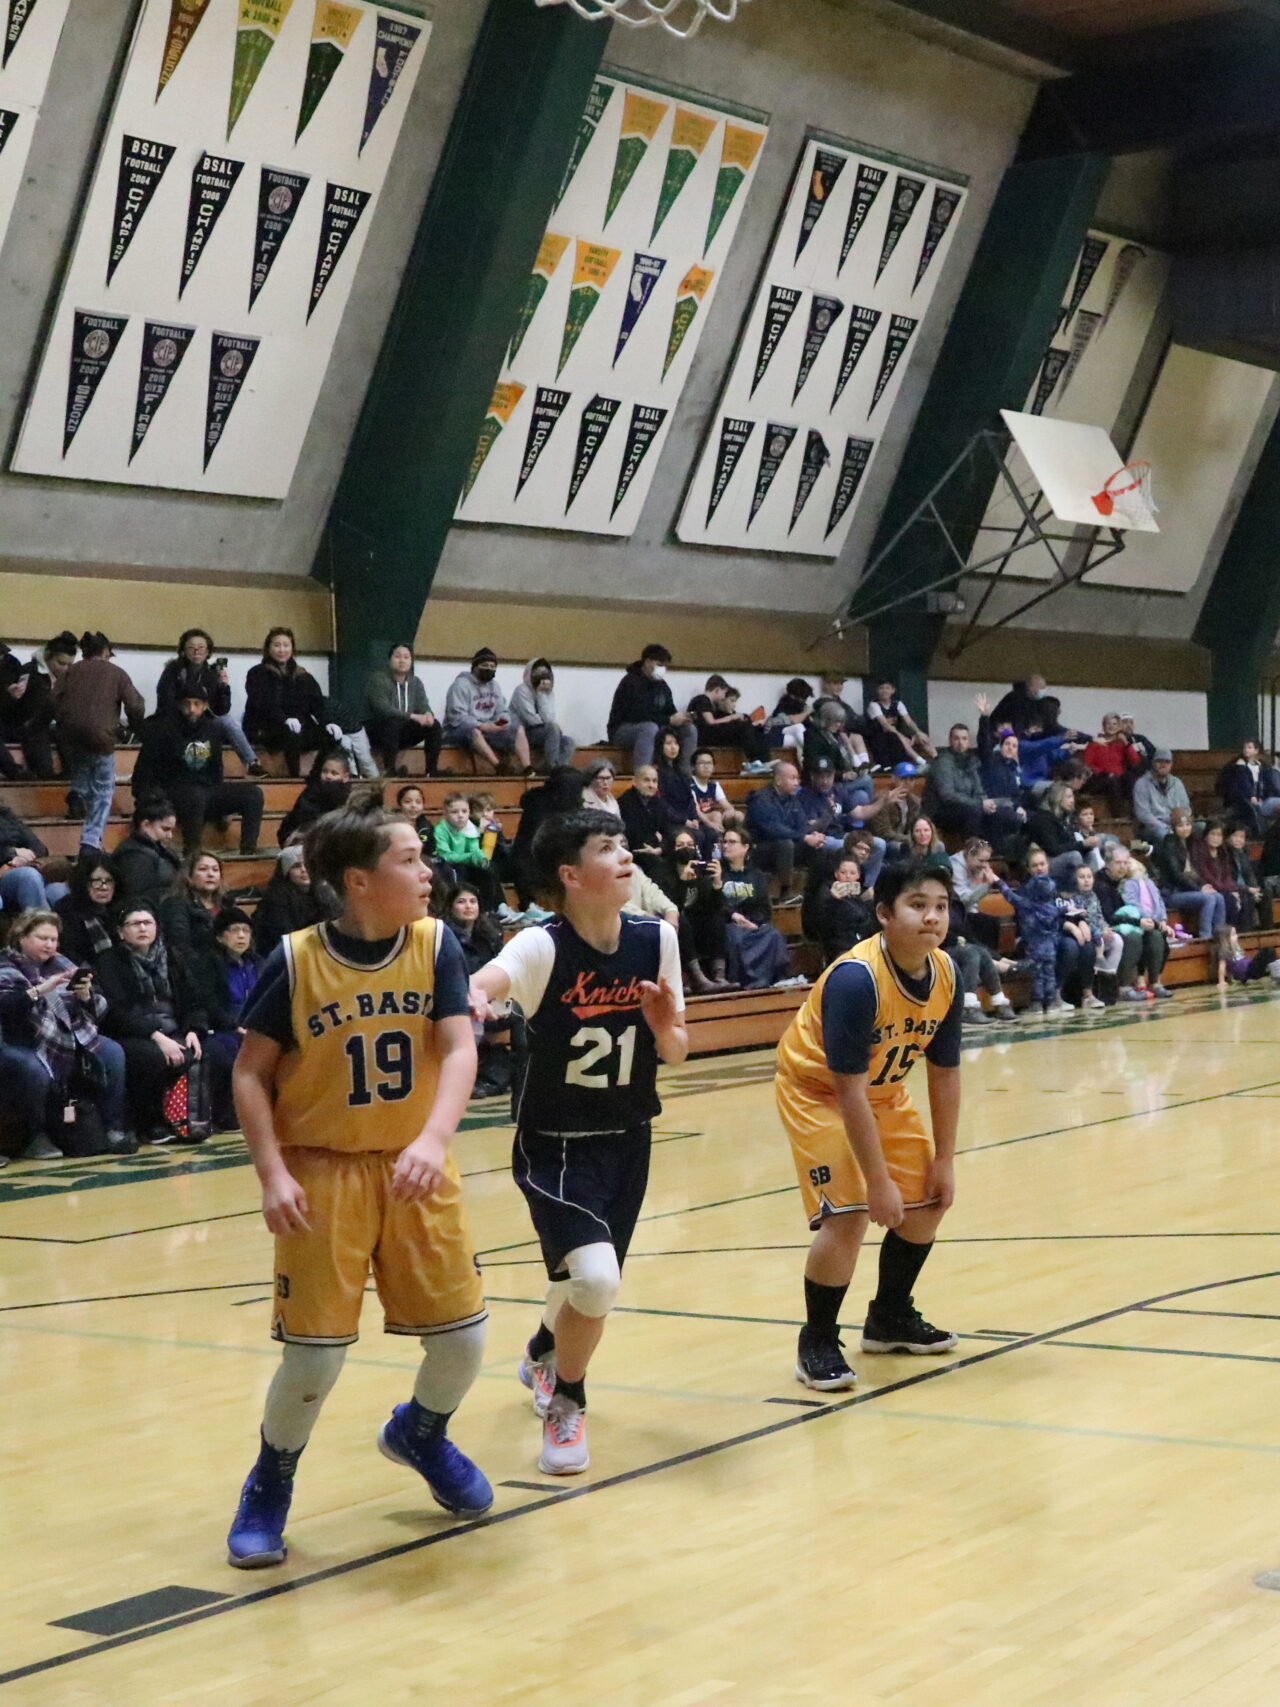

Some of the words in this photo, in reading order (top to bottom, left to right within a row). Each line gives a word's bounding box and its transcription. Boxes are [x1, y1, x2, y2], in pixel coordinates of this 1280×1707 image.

[131, 140, 164, 160] BSAL
[124, 157, 162, 174] FOOTBALL
[203, 158, 233, 175] BSAL
[862, 167, 882, 182] BSAL
[130, 173, 151, 185] 2004
[196, 174, 230, 189] FOOTBALL
[269, 173, 300, 188] FOOTBALL
[334, 188, 361, 206] BSAL
[328, 204, 358, 218] FOOTBALL
[112, 188, 144, 261] CHAMPIONS
[185, 204, 214, 275] CHAMPIONS
[253, 241, 277, 290] FIRST
[313, 232, 342, 298] CHAMPIONS
[776, 288, 796, 301] BSAL
[83, 317, 119, 330] FOOTBALL
[856, 308, 876, 322] BSAL
[894, 316, 913, 330] BSAL
[152, 326, 187, 340] FOOTBALL
[218, 337, 253, 350] FOOTBALL
[541, 390, 564, 405] BSAL
[67, 385, 91, 432] SECOND
[136, 393, 159, 440] FIRST
[639, 408, 660, 421] BSAL
[207, 403, 229, 447] FIRST
[585, 412, 611, 424] SOFTBALL
[728, 420, 749, 433] BSAL
[571, 435, 597, 495] CHAMPIONS
[617, 443, 644, 501] CHAMPIONS
[560, 971, 644, 1004] Knick
[307, 1002, 353, 1037] ST.
[871, 1023, 899, 1044] ST.
[565, 1025, 636, 1088] 21
[870, 1043, 921, 1086] 15
[345, 1029, 414, 1107] 19
[809, 1165, 832, 1187] SB
